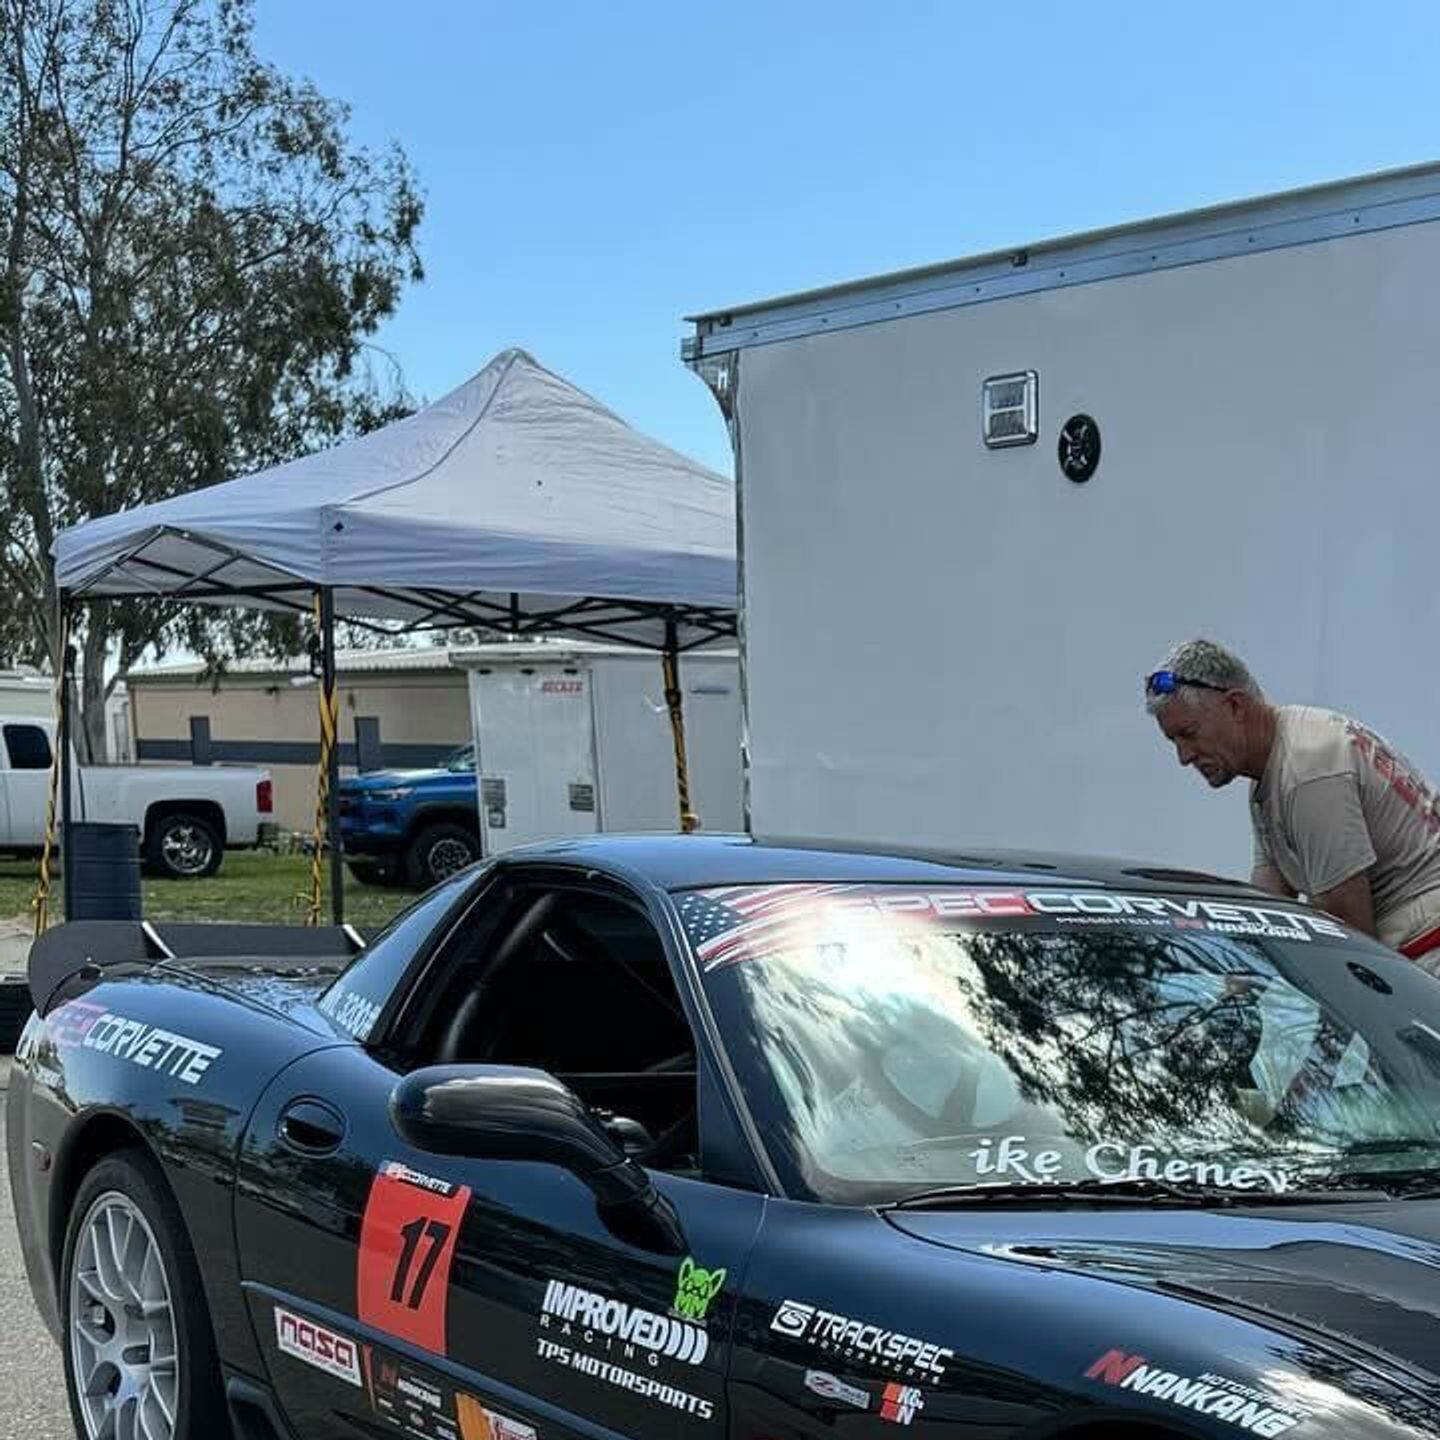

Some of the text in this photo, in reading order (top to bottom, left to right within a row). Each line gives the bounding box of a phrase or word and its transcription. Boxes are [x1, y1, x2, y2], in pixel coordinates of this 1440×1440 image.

[1026, 893, 1348, 939] CORVETTE
[82, 1013, 223, 1084] CORVETTE
[390, 1216, 451, 1311] 17
[540, 1314, 659, 1367] RACING
[542, 1279, 669, 1351] IMPROVED
[812, 1309, 955, 1374] TRACKSPEC
[537, 1338, 714, 1419] TPS MOTORSPORTS
[807, 1336, 940, 1385] MOTORSPORTS
[1120, 1365, 1298, 1439] NANKANG
